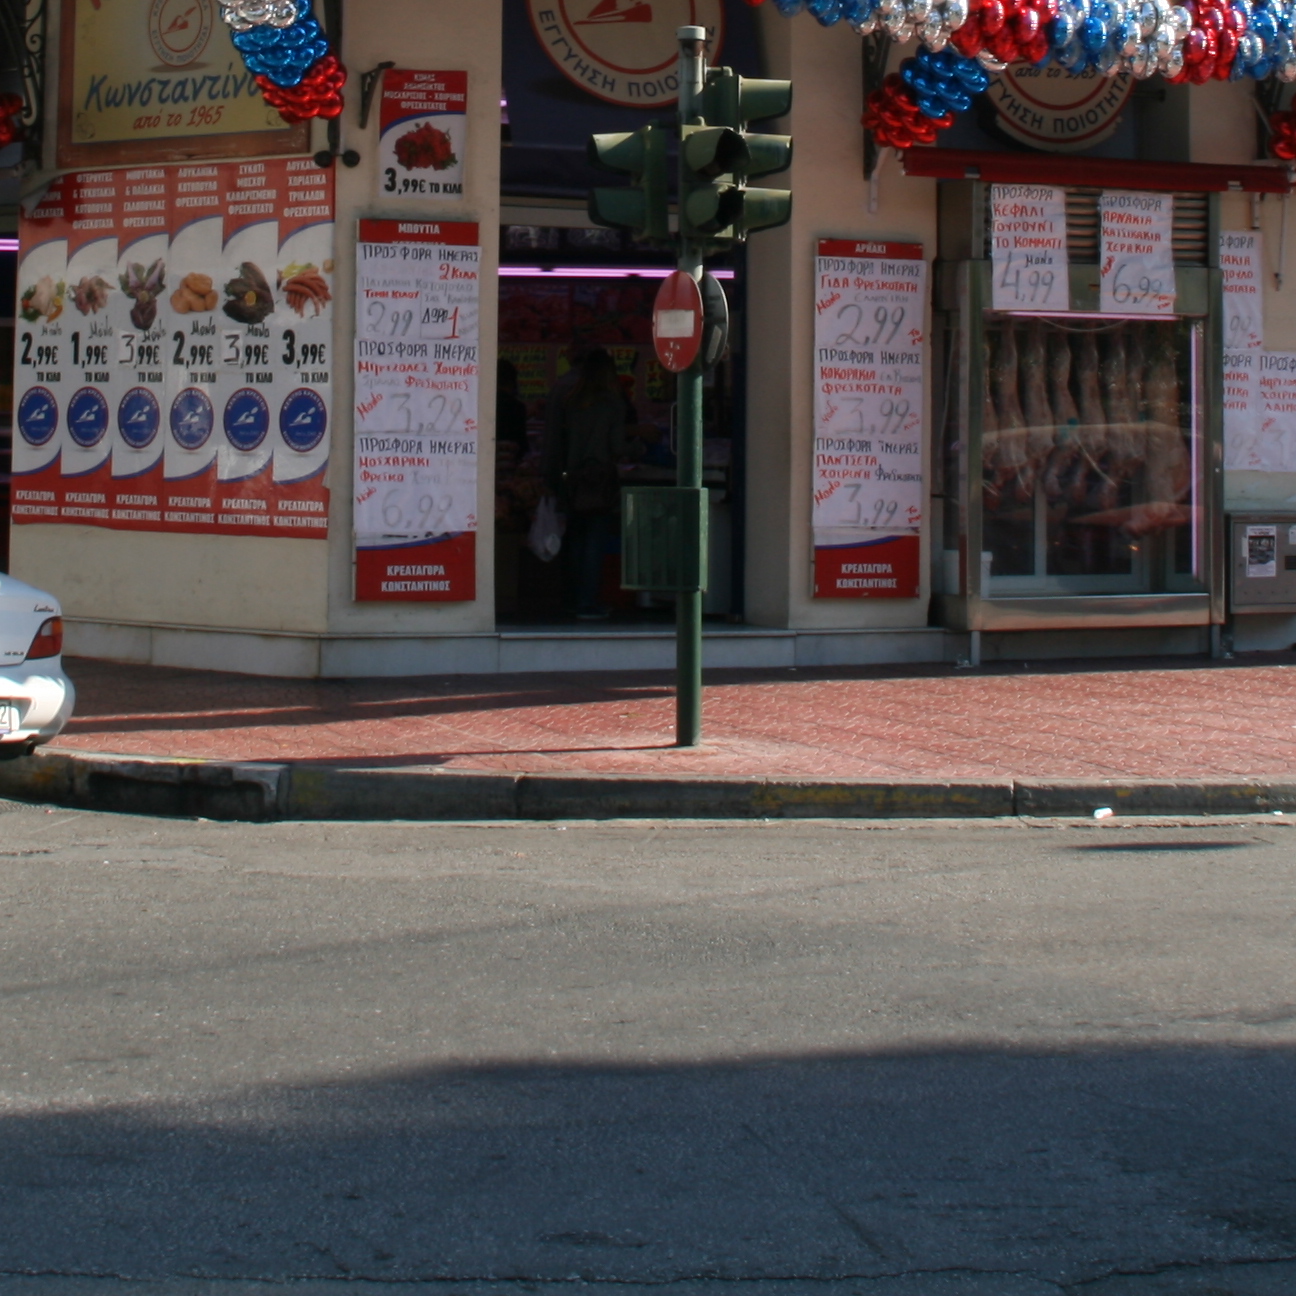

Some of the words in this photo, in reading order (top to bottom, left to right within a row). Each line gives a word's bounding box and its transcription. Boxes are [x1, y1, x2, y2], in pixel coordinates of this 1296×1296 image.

[539, 10, 616, 92] ΕΓΓΥΗΣΗ
[84, 62, 264, 112] Κωνσταντίνο
[1054, 70, 1130, 133] ΠΟΙΟΤΗΤΑ
[133, 110, 161, 130] από
[166, 115, 182, 127] το
[186, 106, 225, 127] 1965
[384, 167, 426, 195] 3,99€
[429, 182, 440, 193] ΤΟ
[444, 183, 463, 193] ΚΙΛΟ
[993, 186, 1053, 201] ΠΡΟΣΦΟΡΑ
[283, 206, 330, 218] ΦΡΕΣΚΟΤΑΤΑ
[993, 203, 1044, 218] ΚΕΦΑΛΙ
[1103, 211, 1152, 225] ΑΡΝΑΚΙΑ
[398, 223, 441, 235] ΜΠΟΥΤΙΑ
[855, 243, 887, 254] ΑΡΝΑΚΙ
[1014, 235, 1062, 250] ΚΟΜΜΑΤΙ
[438, 249, 479, 262] ΗΜΕΡΑΣ
[439, 263, 450, 280] 2
[818, 258, 874, 275] ΠΡΟΣΦΟΡΑ
[880, 261, 920, 277] ΗΜΕΡΑΣ
[1000, 251, 1054, 304] 4,99
[1112, 264, 1162, 304] 6,99
[445, 306, 460, 340] 1
[835, 304, 905, 345] 2,99
[21, 332, 59, 368] 2,99€
[71, 331, 108, 368] 1,99€
[119, 334, 160, 369] 3,99€
[172, 330, 214, 369] 2,99€
[224, 333, 269, 368] 3,99€
[282, 329, 326, 369] 3,99€
[359, 341, 428, 358] ΠΡΟΣΦΟΡΑ
[434, 343, 477, 362] ΗΜΕΡΑΣ
[819, 348, 874, 364] ΠΡΟΣΦΟΡΑ
[880, 351, 920, 364] ΗΜΕΡΑΣ
[37, 372, 44, 382] ΤΟ
[46, 372, 61, 382] ΚΙΛΟ
[85, 372, 93, 382] ΤΟ
[94, 372, 110, 382] ΚΙΛΟ
[138, 372, 146, 382] ΤΟ
[148, 372, 163, 382] ΚΙΛΟ
[190, 372, 198, 383] ΤΟ
[200, 372, 216, 383] ΚΙΛΟ
[245, 372, 254, 383] ΤΟ
[256, 372, 273, 383] ΚΙΛΟ
[301, 372, 309, 383] ΤΟ
[311, 372, 328, 383] ΚΙΛΟ
[820, 366, 876, 381] ΚΟΚΟΡΑΚΙΑ
[822, 383, 902, 395] ΦΡΕΣΚΟΤΑΤΑ
[835, 397, 910, 435] 3,99
[359, 437, 423, 453] ΠΡΟΣΦΟΡΑ
[429, 440, 476, 454] ΗΜΕΡΑΣ
[816, 437, 872, 452] ΠΡΟΣΦΟΡΑ
[359, 456, 430, 468] ΜΟΣΧΑΡΑΚΙ
[817, 455, 878, 467] ΠΑΝΤΣΕΤΑ
[16, 490, 55, 501] ΚΡΕΑΤΑΓΟΡΑ
[65, 492, 106, 503] ΚΡΕΑΤΑΓΟΡΑ
[116, 494, 157, 506] ΚΡΕΑΤΑΓΟΡΑ
[168, 496, 212, 508] ΚΡΕΑΤΑΓΟΡΑ
[222, 498, 267, 511] ΚΡΕΑΤΑΓΟΡΑ
[278, 500, 324, 512] ΚΡΕΑΤΑΓΟΡΑ
[382, 488, 453, 529] 6,99
[839, 483, 898, 526] 3,99
[164, 511, 215, 524] ΚΩΝΣΤΑΝΤΙΝΟΣ
[218, 513, 271, 526] ΚΩΝΣΤΑΝΤΙΝΟΣ
[273, 515, 328, 528] ΚΩΝΣΤΑΝΤΙΝΟΣ
[387, 565, 445, 576] ΚΡΕΑΤΑΓΟΡΑ
[841, 563, 893, 574] ΚΡΕΑΤΑΓΟΡΑ
[381, 581, 451, 592] ΚΩΝΣΤΑΝΤΙΝΟΣ
[836, 578, 897, 589] ΚΩΝΣΤΑΝΤΙΝΟΣ
